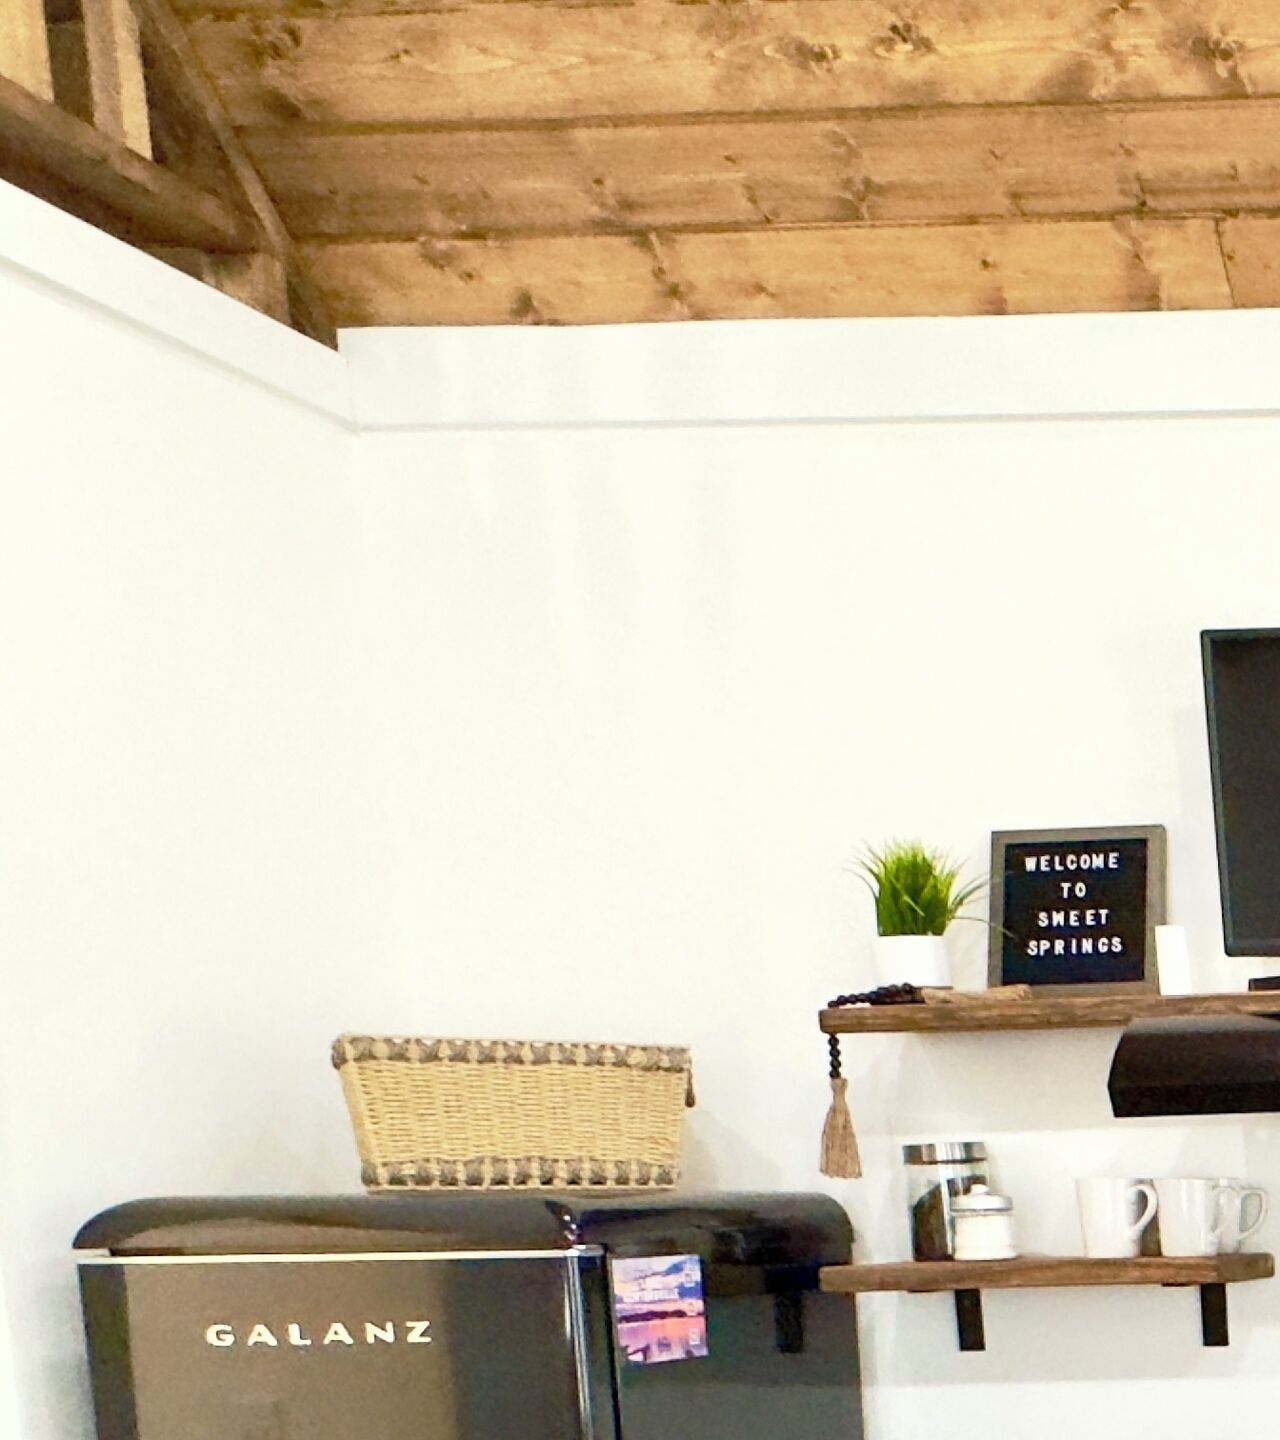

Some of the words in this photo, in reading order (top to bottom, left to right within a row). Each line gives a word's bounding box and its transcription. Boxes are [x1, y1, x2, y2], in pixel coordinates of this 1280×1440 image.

[1025, 852, 1120, 872] WELCOME
[1060, 882, 1087, 899] TO
[1037, 909, 1110, 928] SWEET
[1027, 936, 1122, 956] SPRINGS
[206, 1321, 432, 1346] GALANZ
